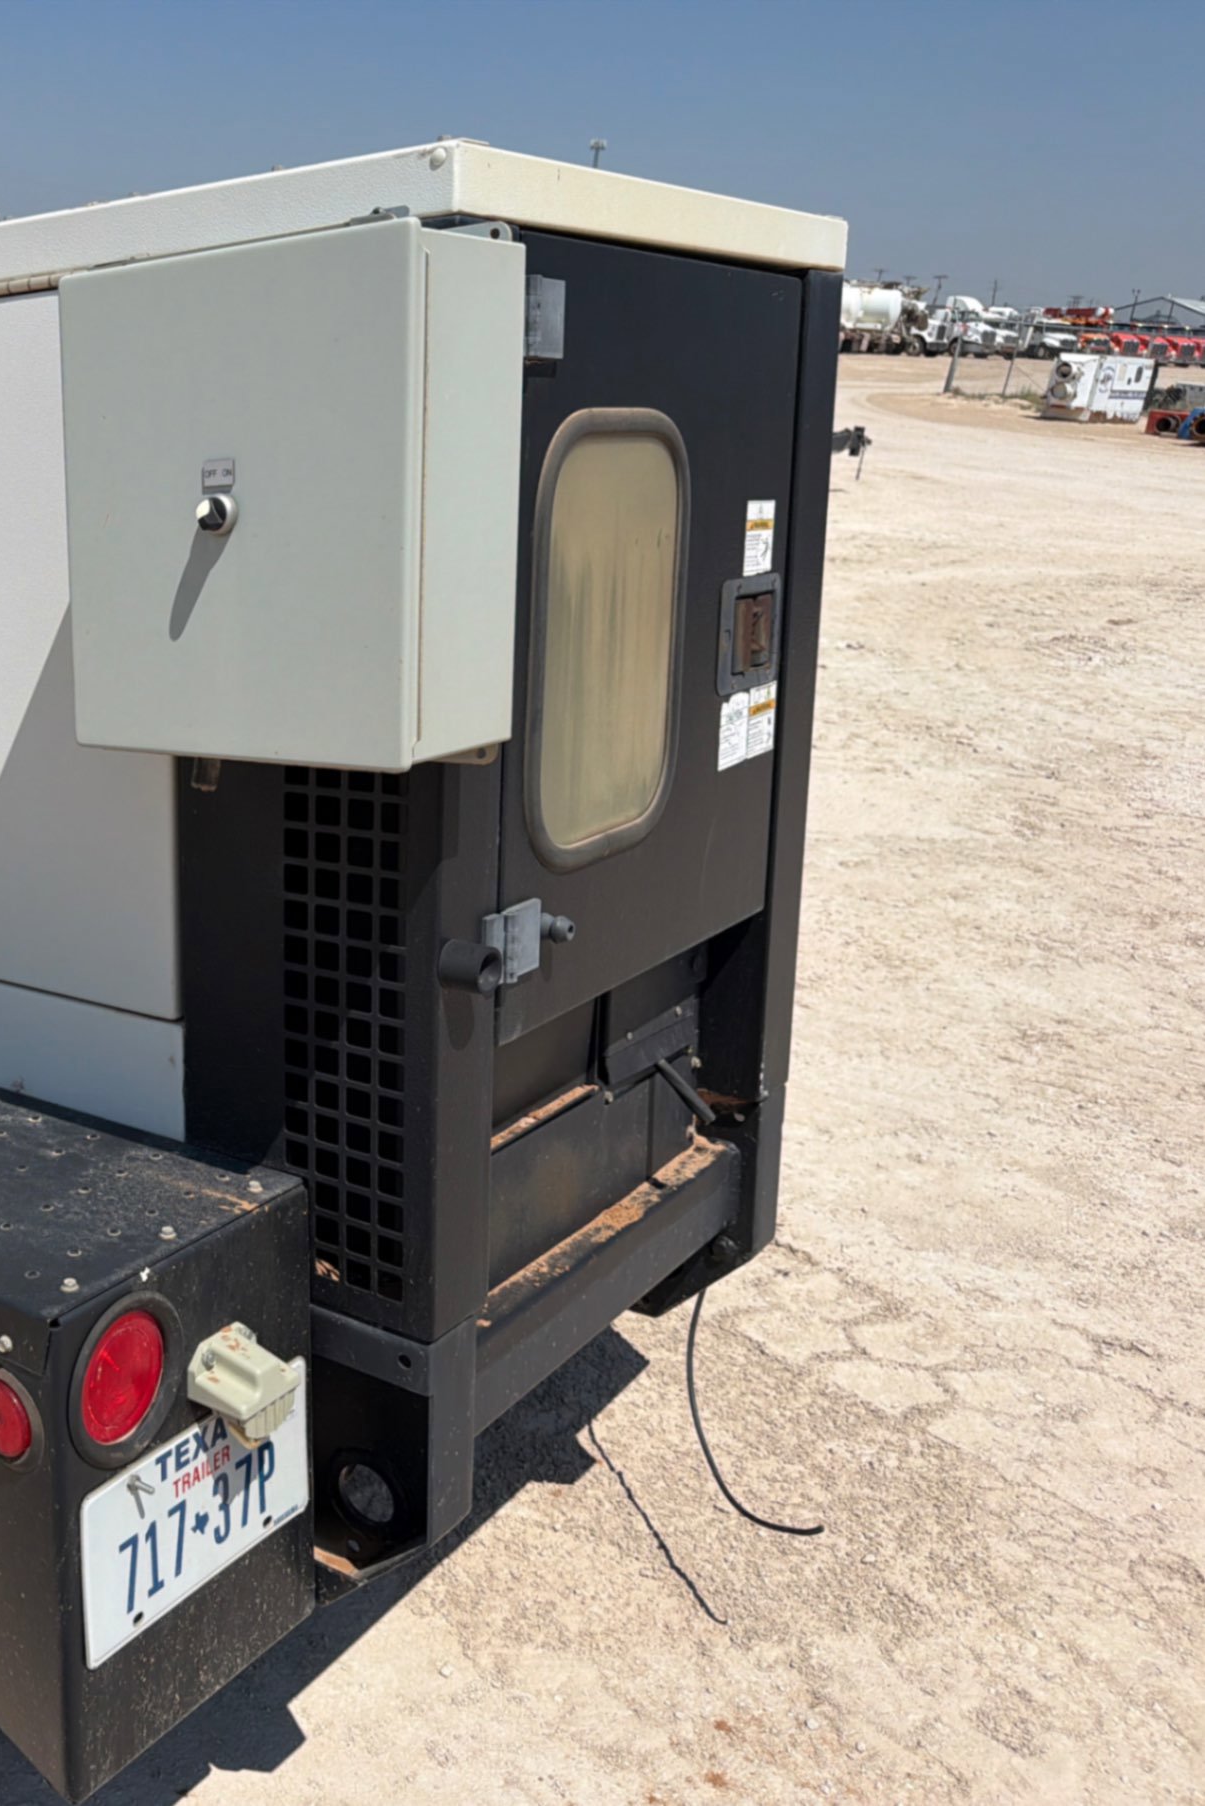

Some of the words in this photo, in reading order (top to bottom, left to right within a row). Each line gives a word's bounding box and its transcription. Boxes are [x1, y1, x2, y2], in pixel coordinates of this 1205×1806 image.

[155, 1415, 228, 1483] TEXA
[172, 1444, 231, 1500] TRAILER
[118, 1499, 187, 1616] 717
[212, 1440, 276, 1546] 37P
